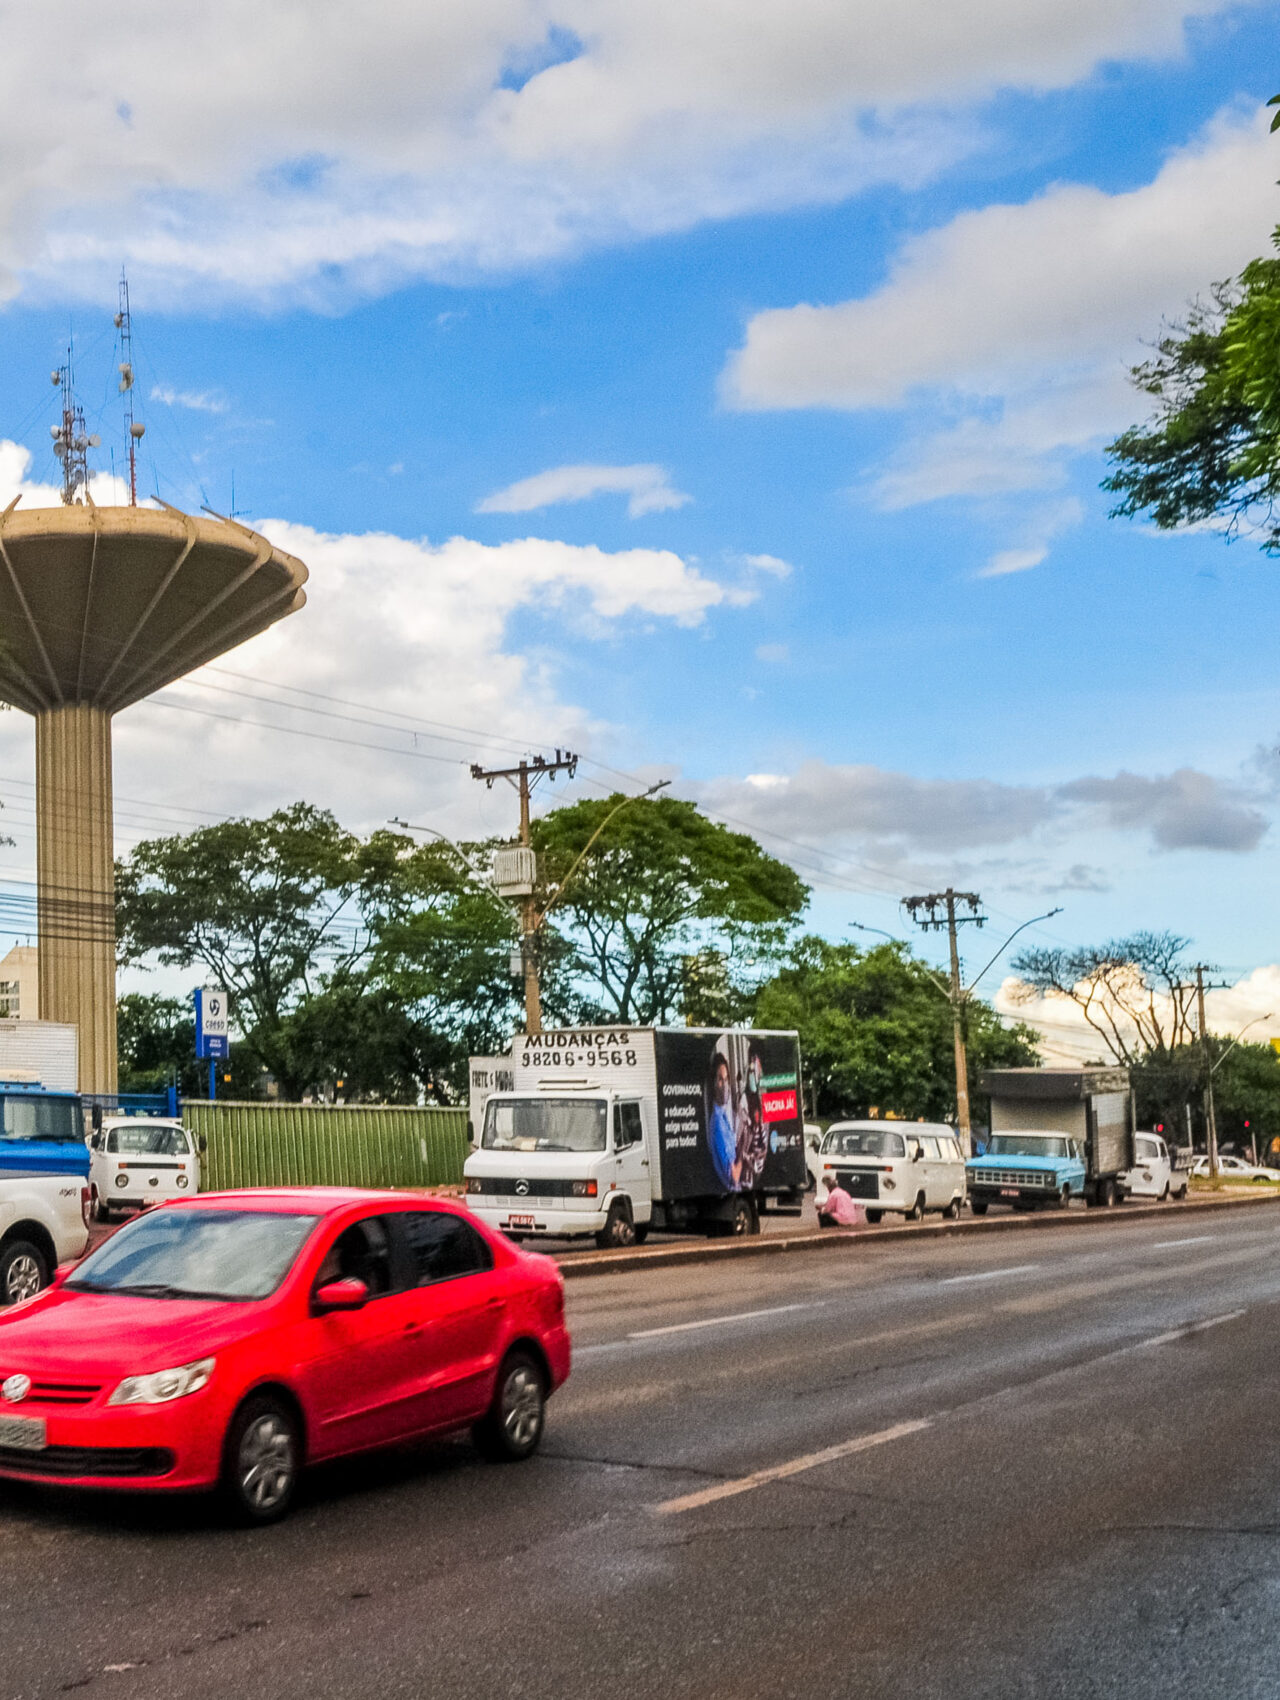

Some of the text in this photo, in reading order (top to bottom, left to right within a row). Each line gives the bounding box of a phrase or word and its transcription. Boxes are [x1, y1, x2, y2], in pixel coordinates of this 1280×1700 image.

[525, 1032, 630, 1049] MUDANÇAS
[472, 1070, 488, 1088] FRETE
[662, 1084, 702, 1096] GOVERNADOR,
[669, 1104, 696, 1118] educação
[764, 1099, 785, 1113] VACINA
[665, 1121, 699, 1134] exige vacina
[665, 1138, 679, 1151] para
